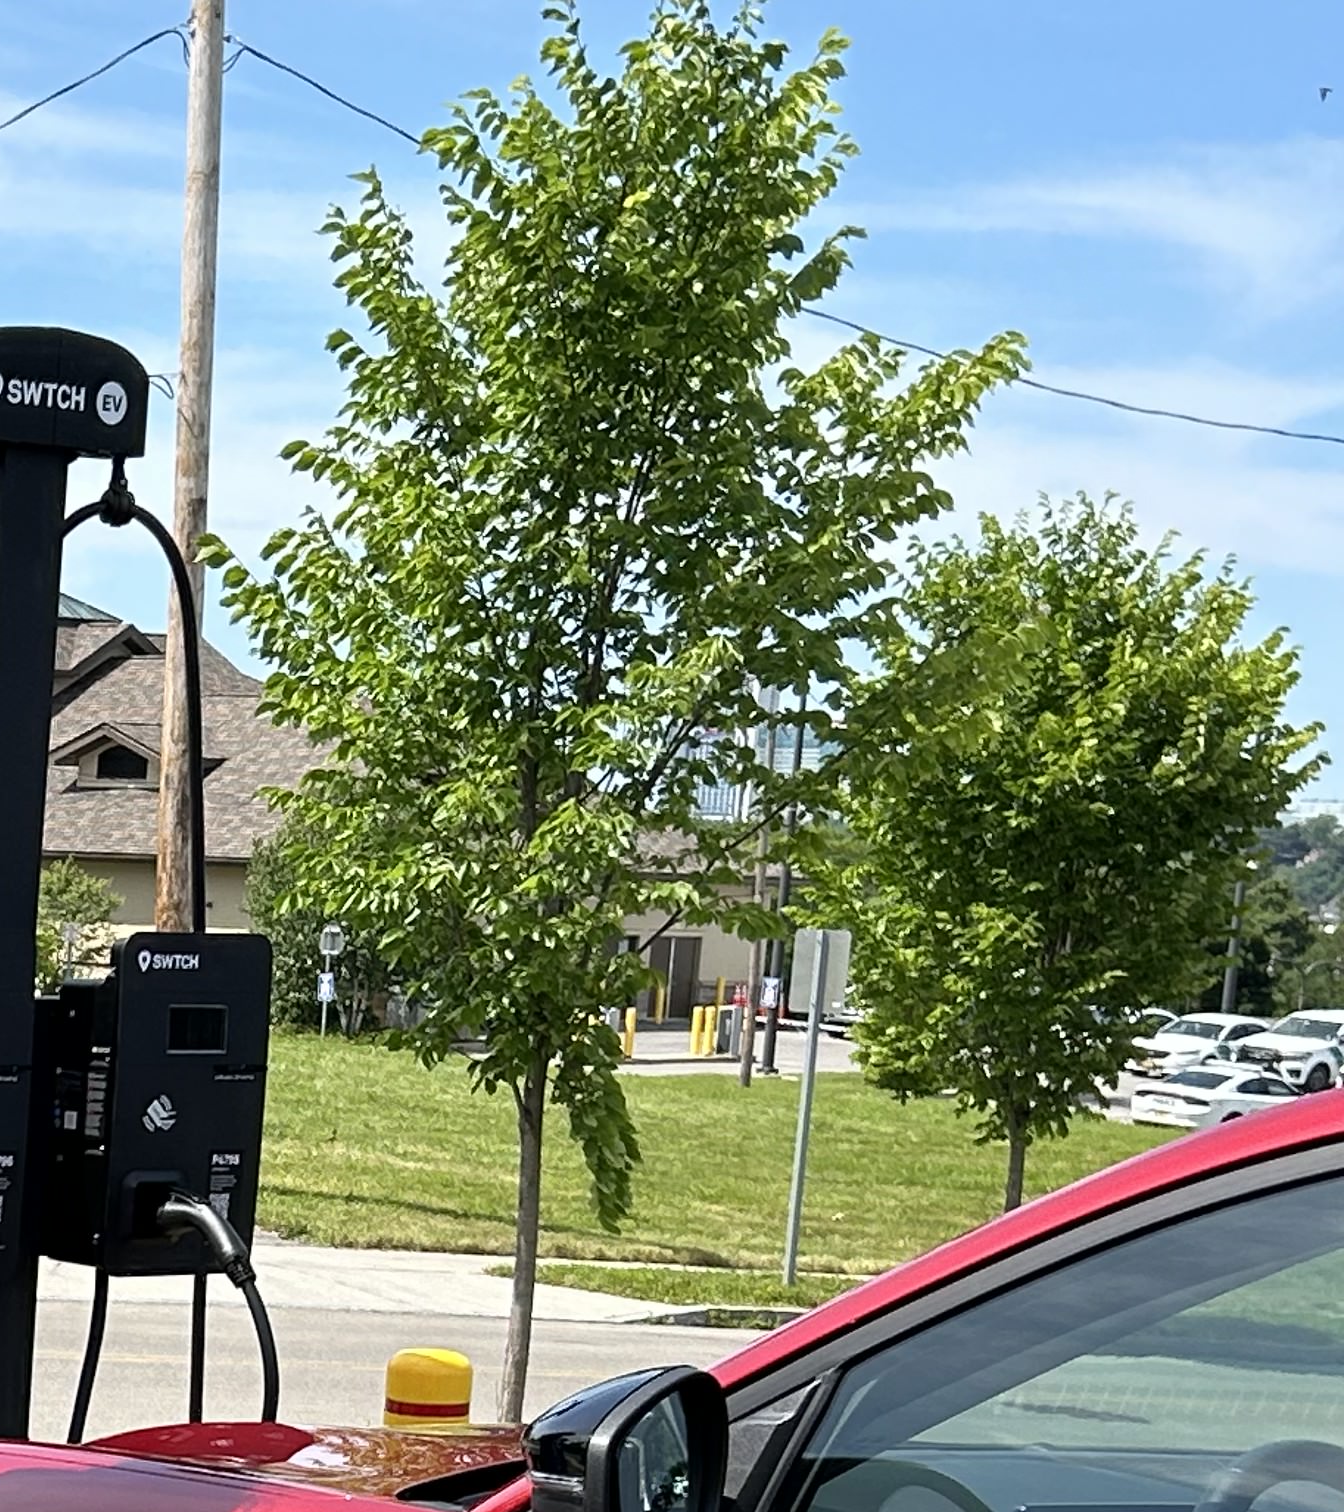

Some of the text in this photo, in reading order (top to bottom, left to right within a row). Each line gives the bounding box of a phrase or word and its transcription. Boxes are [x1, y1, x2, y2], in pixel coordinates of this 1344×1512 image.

[6, 378, 123, 413] SWTCH EV
[152, 953, 200, 969] SWTCH
